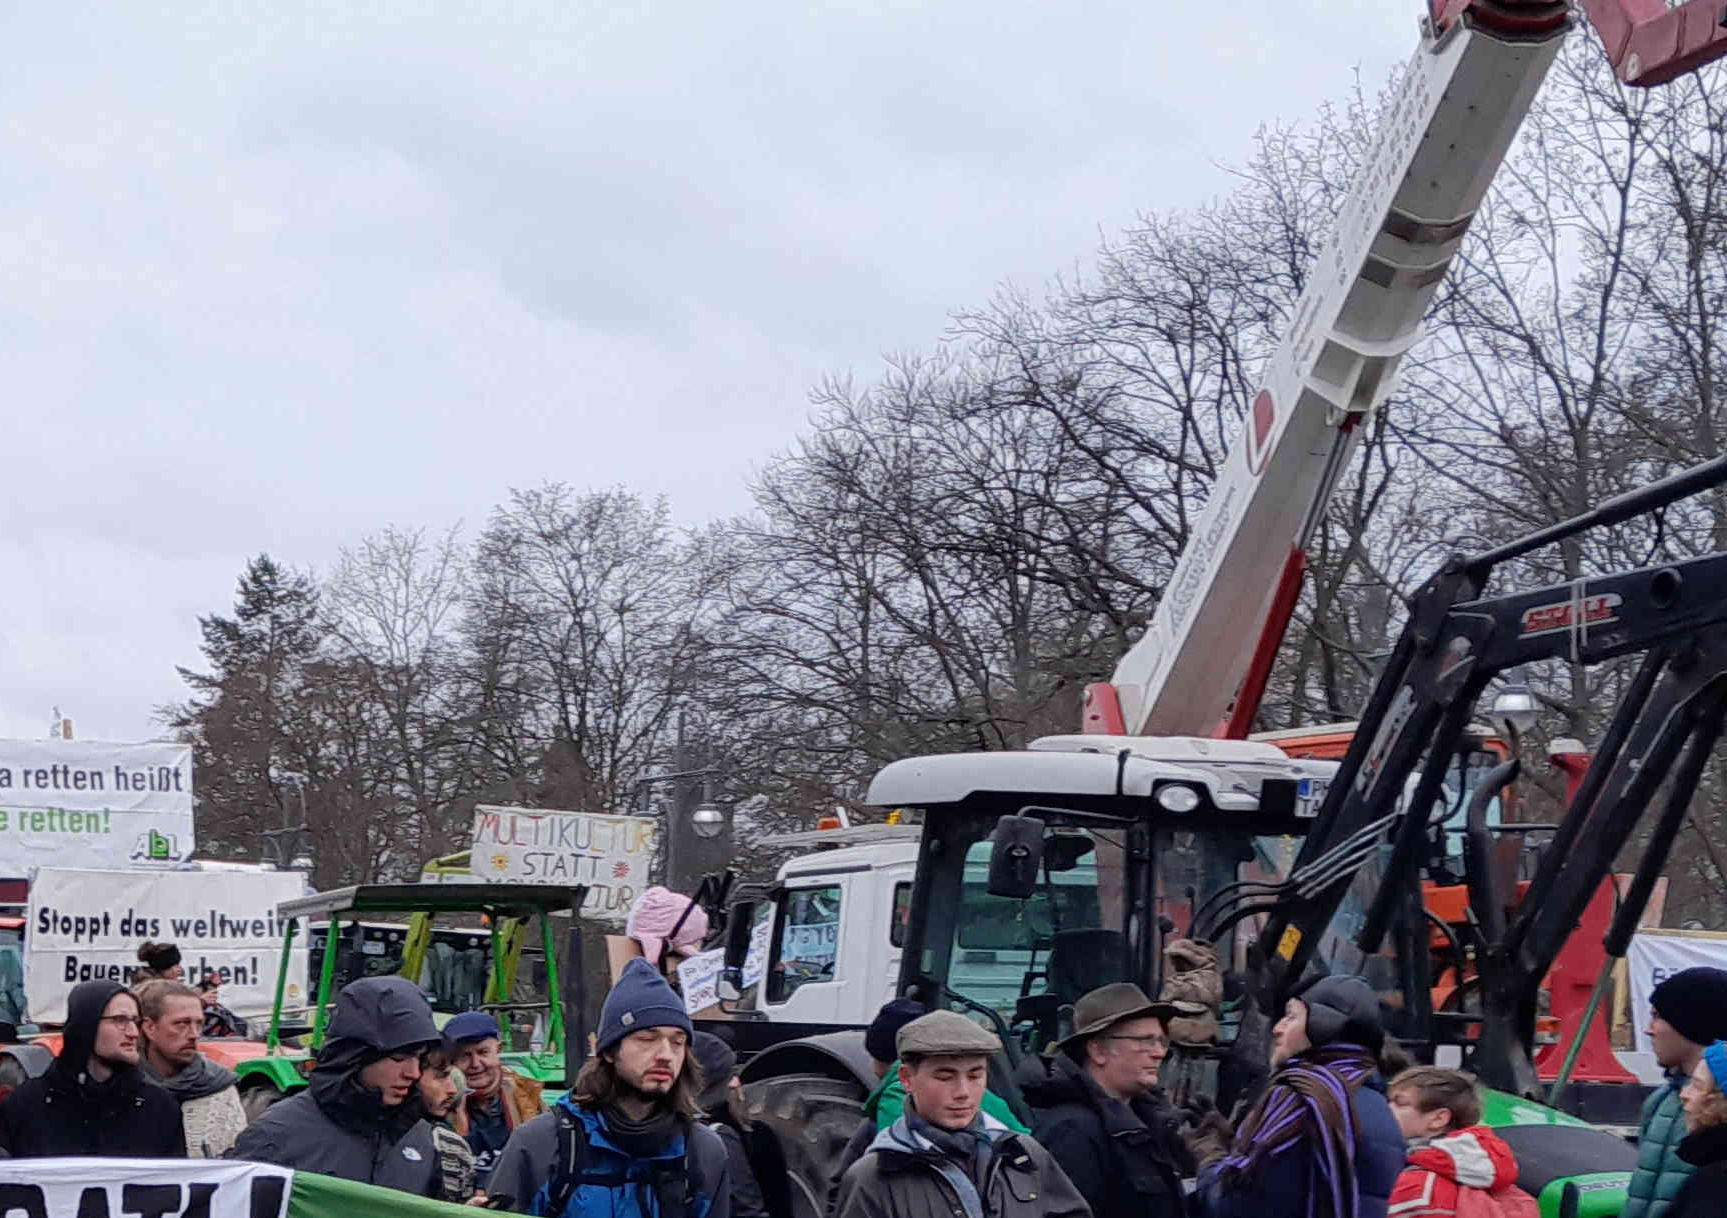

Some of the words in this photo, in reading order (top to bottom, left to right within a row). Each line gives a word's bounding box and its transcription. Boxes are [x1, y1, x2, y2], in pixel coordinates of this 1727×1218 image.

[23, 764, 105, 791] retten
[114, 765, 184, 793] heißt
[18, 806, 111, 834] retten!
[522, 851, 605, 880] STATT
[37, 906, 111, 943] Stoppt
[120, 908, 161, 938] das
